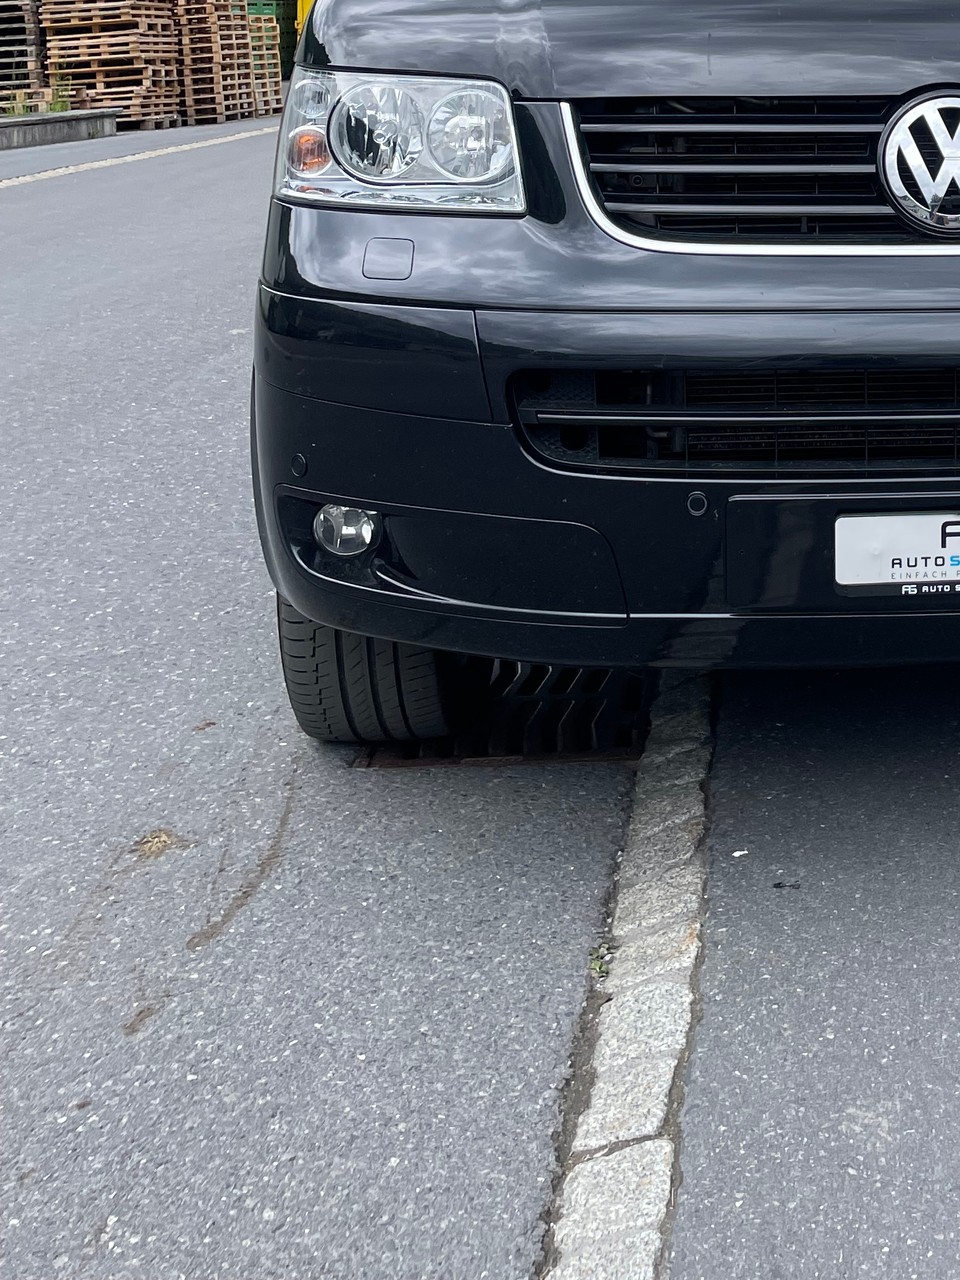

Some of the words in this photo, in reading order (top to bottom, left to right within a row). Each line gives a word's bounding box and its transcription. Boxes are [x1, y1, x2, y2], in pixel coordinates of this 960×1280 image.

[891, 570, 947, 580] EINFACH
[901, 584, 918, 595] AS
[922, 584, 951, 593] AUTO
